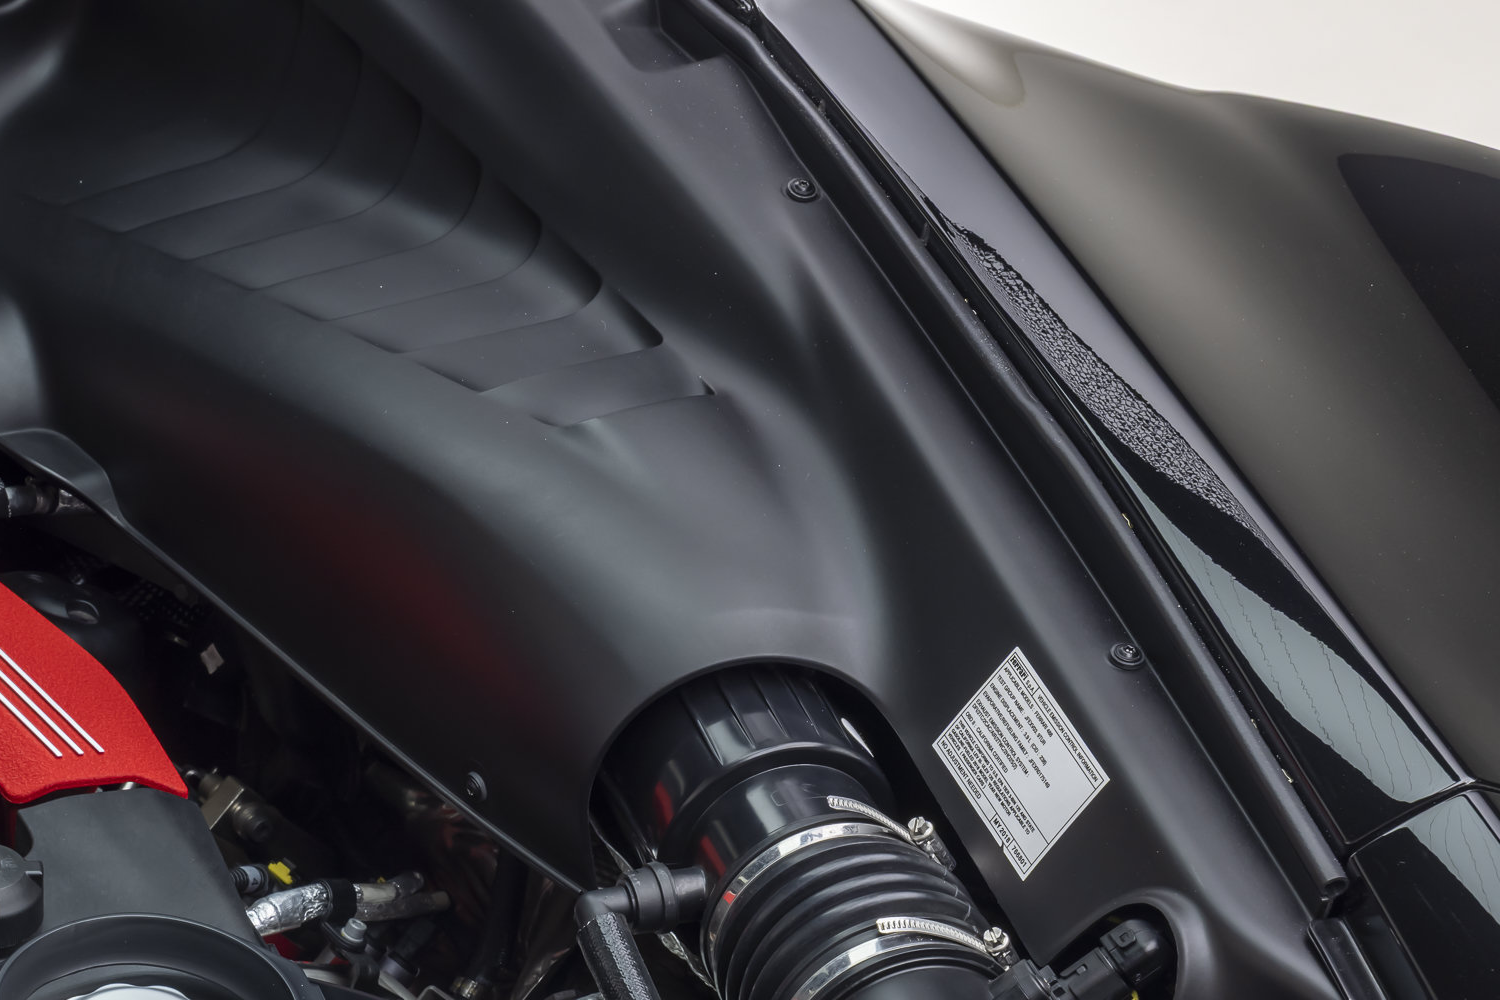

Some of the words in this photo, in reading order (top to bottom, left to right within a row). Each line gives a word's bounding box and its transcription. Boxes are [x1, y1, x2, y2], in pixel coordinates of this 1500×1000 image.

[996, 673, 1006, 687] TEST
[1002, 683, 1016, 702] GROUP
[1009, 654, 1029, 681] Ferrari
[988, 681, 1002, 700] ENGINE
[999, 697, 1023, 731] DISPLACEMENT
[1002, 665, 1023, 693] APPLICABLE
[1033, 709, 1048, 730] FERRARI
[1045, 727, 1054, 738] 488
[946, 731, 961, 752] VEHICLES
[964, 710, 974, 723] OBD
[975, 725, 994, 753] CALIFORNIA
[991, 749, 1009, 774] CERTIFIED
[975, 697, 990, 719] EXHAUST
[987, 716, 1004, 739] EMISSION
[1001, 735, 1018, 759] CONTROL
[1014, 755, 1029, 775] SYSTEM
[1015, 738, 1028, 756] FAMILY
[1036, 693, 1051, 714] VEHICLE
[1048, 711, 1065, 734] EMISSION
[1061, 730, 1079, 754] CONTROL
[1075, 750, 1099, 783] INFORMATION
[939, 739, 948, 750] NO
[945, 747, 968, 780] ADJUSTMENT
[965, 777, 982, 800] NEEDED
[953, 723, 960, 732] OF
[957, 728, 975, 753] CALIFORNIA
[991, 778, 1011, 807] REGULATIONS
[1008, 804, 1027, 829] APPLICABLE
[1024, 826, 1031, 835] TO
[957, 719, 966, 730] THIS
[963, 727, 976, 746] VEHICLE
[973, 742, 990, 766] CONFORMS
[987, 763, 994, 772] TO
[1019, 809, 1028, 821] AND
[1024, 818, 1035, 833] STATE
[977, 767, 989, 784] MODEL
[986, 781, 996, 794] YEAR
[993, 791, 1002, 803] NEW
[999, 799, 1012, 817] MOTOR
[992, 817, 1001, 829] MY
[998, 826, 1011, 844] 2018
